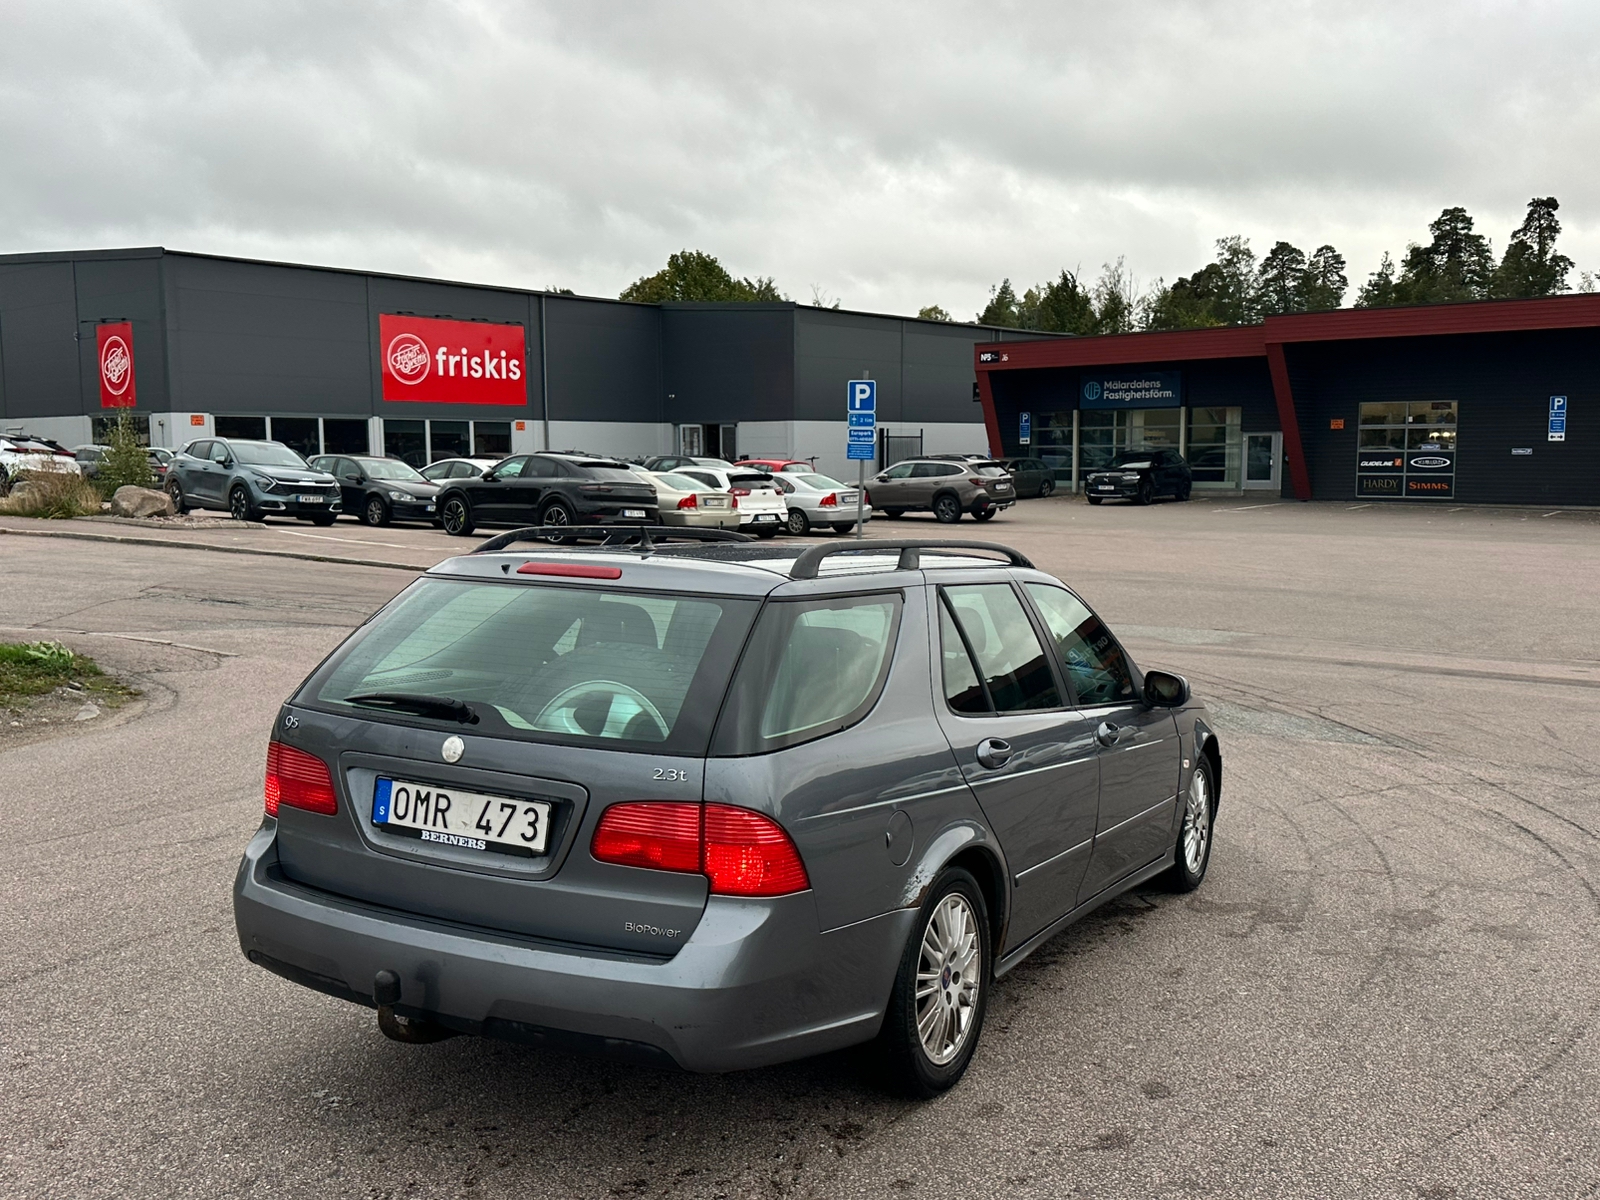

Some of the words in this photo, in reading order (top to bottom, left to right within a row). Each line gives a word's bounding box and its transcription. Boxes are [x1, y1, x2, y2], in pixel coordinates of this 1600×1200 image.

[435, 346, 521, 380] friskis
[1103, 380, 1161, 390] Mälardalens
[855, 384, 871, 408] P
[1553, 397, 1564, 410] P
[1022, 413, 1029, 423] P
[1363, 479, 1399, 488] HARDY
[1409, 481, 1449, 490] SIMMS
[652, 767, 688, 782] 2.3t
[379, 805, 386, 816] S
[393, 786, 453, 830] OMR
[475, 799, 540, 843] 473
[421, 829, 486, 851] BERNERS
